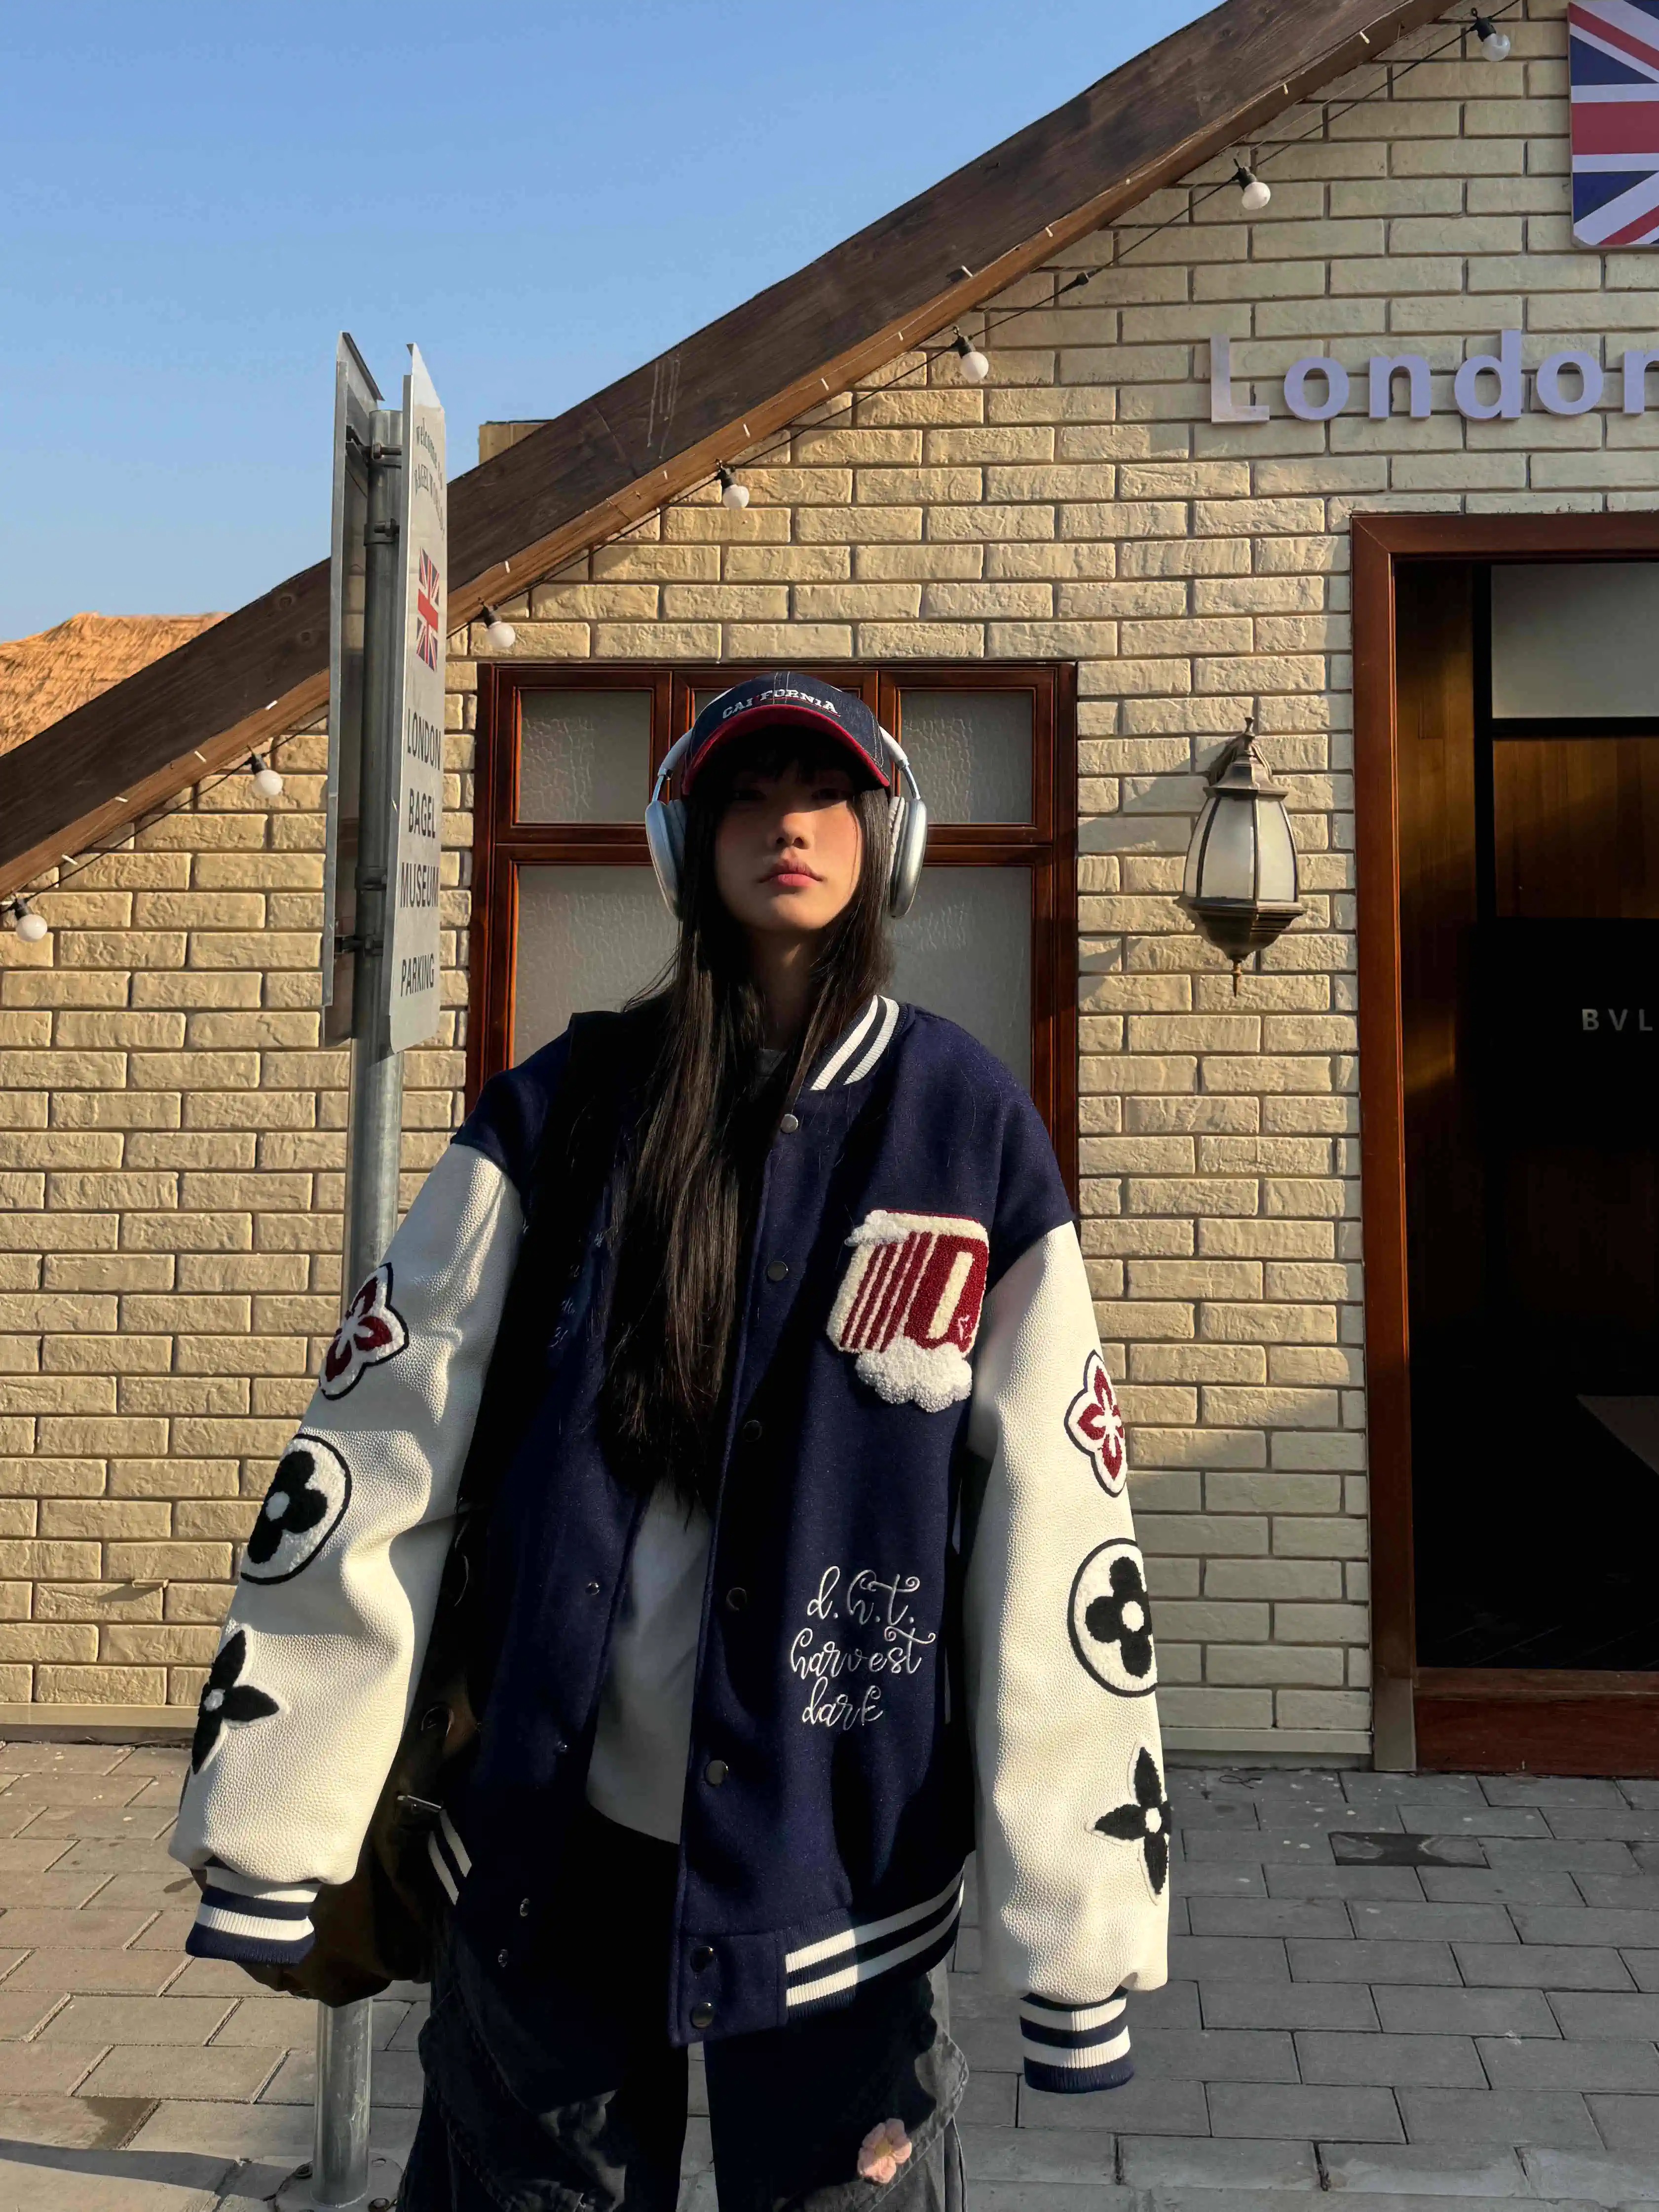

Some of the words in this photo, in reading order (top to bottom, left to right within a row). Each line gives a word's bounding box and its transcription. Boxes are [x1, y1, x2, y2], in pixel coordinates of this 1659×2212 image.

[408, 708, 441, 770] LONDON
[409, 788, 435, 838] BAGEL
[401, 862, 439, 908] MUSEUM
[401, 953, 434, 997] PARKING
[790, 1626, 936, 1680] harvest
[801, 1676, 884, 1730] dark
